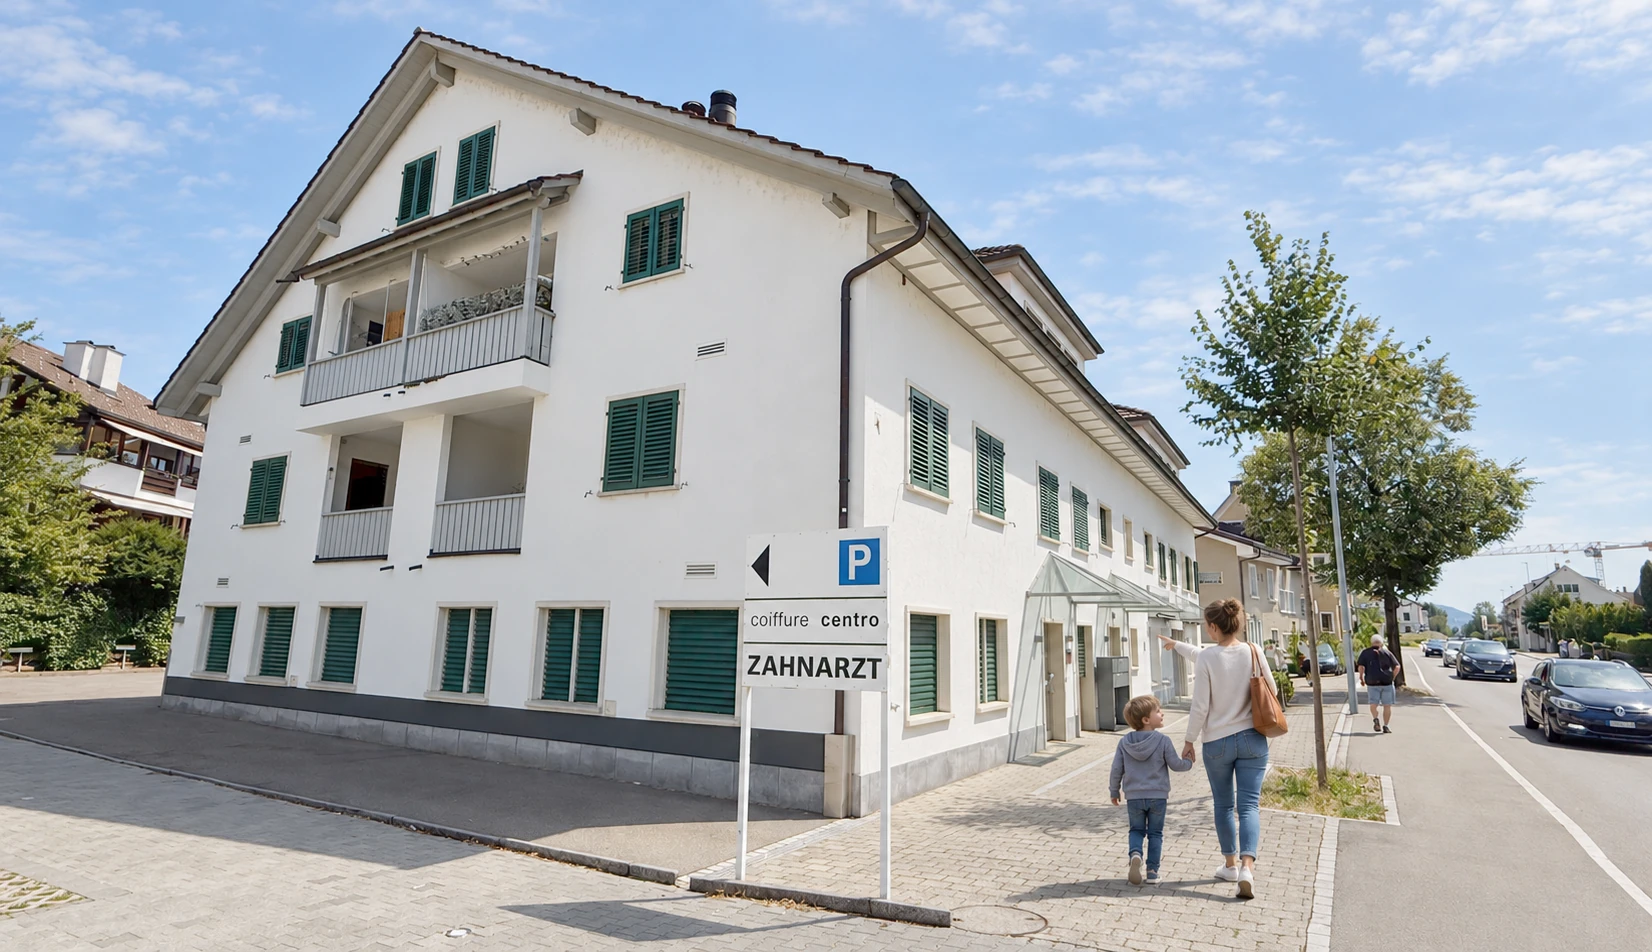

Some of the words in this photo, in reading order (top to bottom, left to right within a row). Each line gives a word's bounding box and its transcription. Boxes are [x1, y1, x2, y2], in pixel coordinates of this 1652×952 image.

[848, 544, 872, 580] P
[751, 612, 809, 627] coiffure
[821, 612, 879, 627] centro
[747, 655, 882, 679] ZAHNARZT
